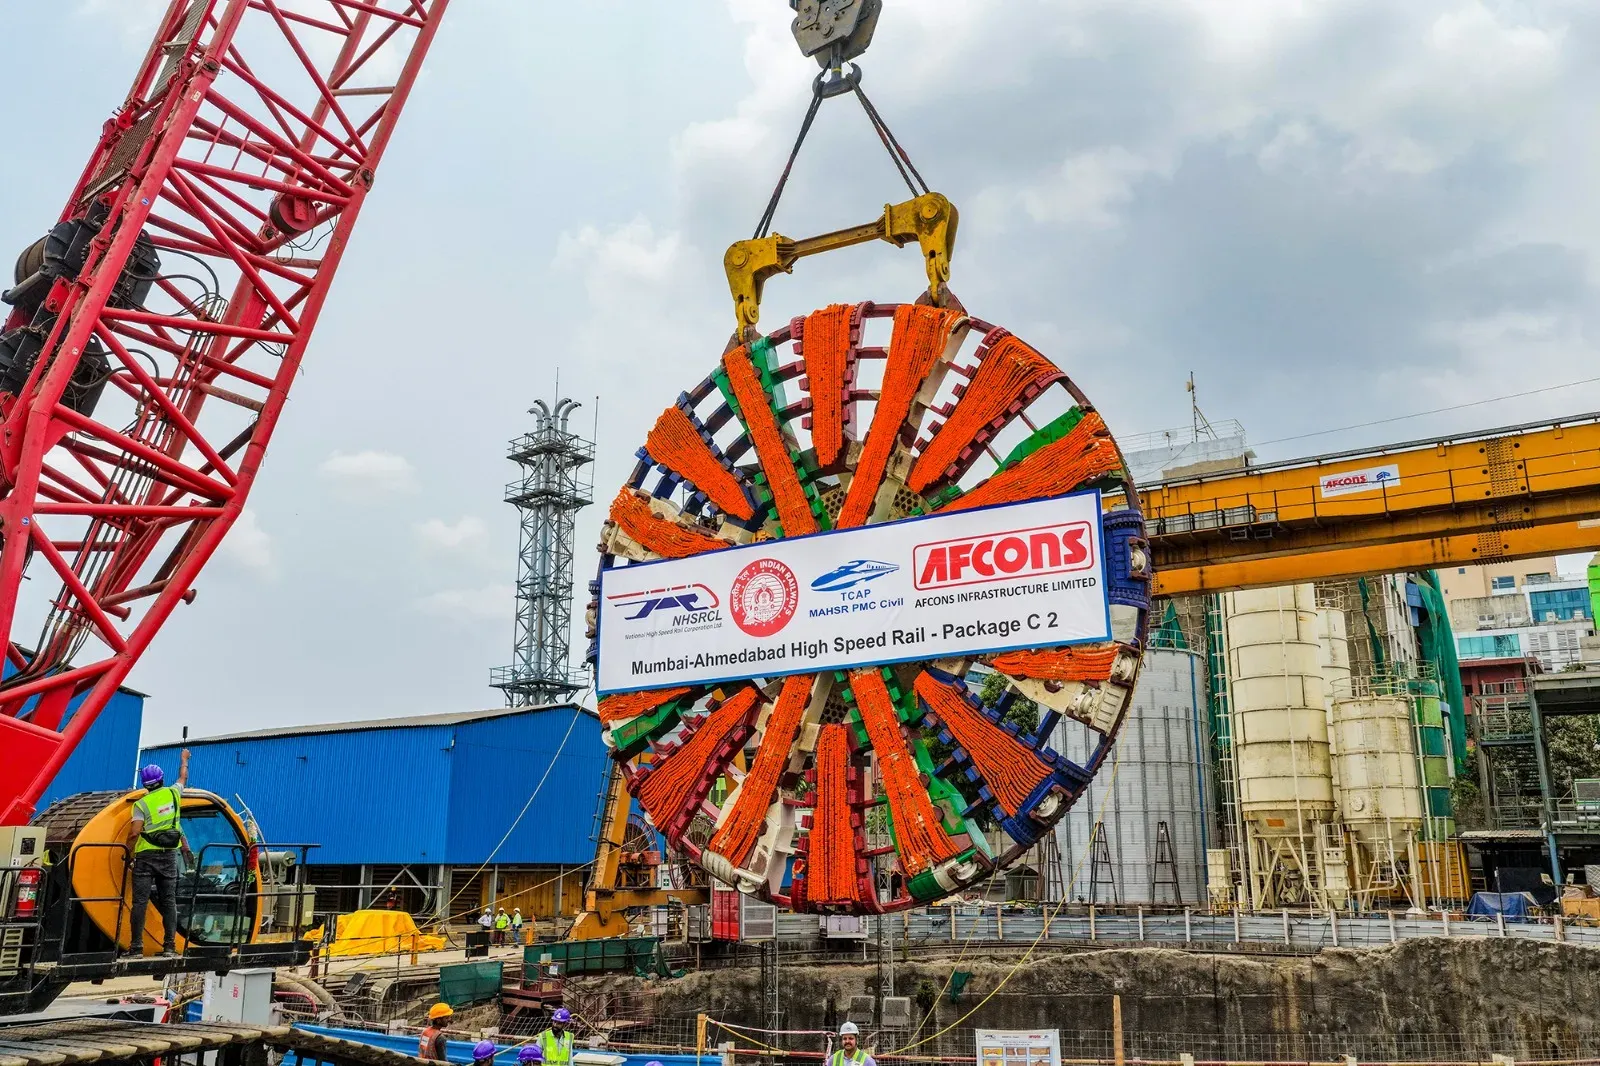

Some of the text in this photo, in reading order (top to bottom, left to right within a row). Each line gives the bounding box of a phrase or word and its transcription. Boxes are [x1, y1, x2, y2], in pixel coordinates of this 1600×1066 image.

[760, 561, 797, 616] INDIAN RAILWAYS
[840, 589, 871, 602] TCAP
[914, 577, 1097, 608] AFCONS INFRASTRUCTURE LIMITED
[672, 610, 723, 626] NHSRCL
[809, 598, 904, 618] MAHSR PMC Civil
[658, 628, 673, 636] Speed
[684, 623, 713, 633] Corporation
[631, 644, 786, 675] Mumbai-Ahmedabad
[791, 639, 828, 658] High
[833, 630, 886, 655] Speed
[892, 627, 926, 645] Rail
[943, 619, 1021, 641] Package
[1027, 613, 1041, 630] C
[1047, 611, 1059, 628] 2
